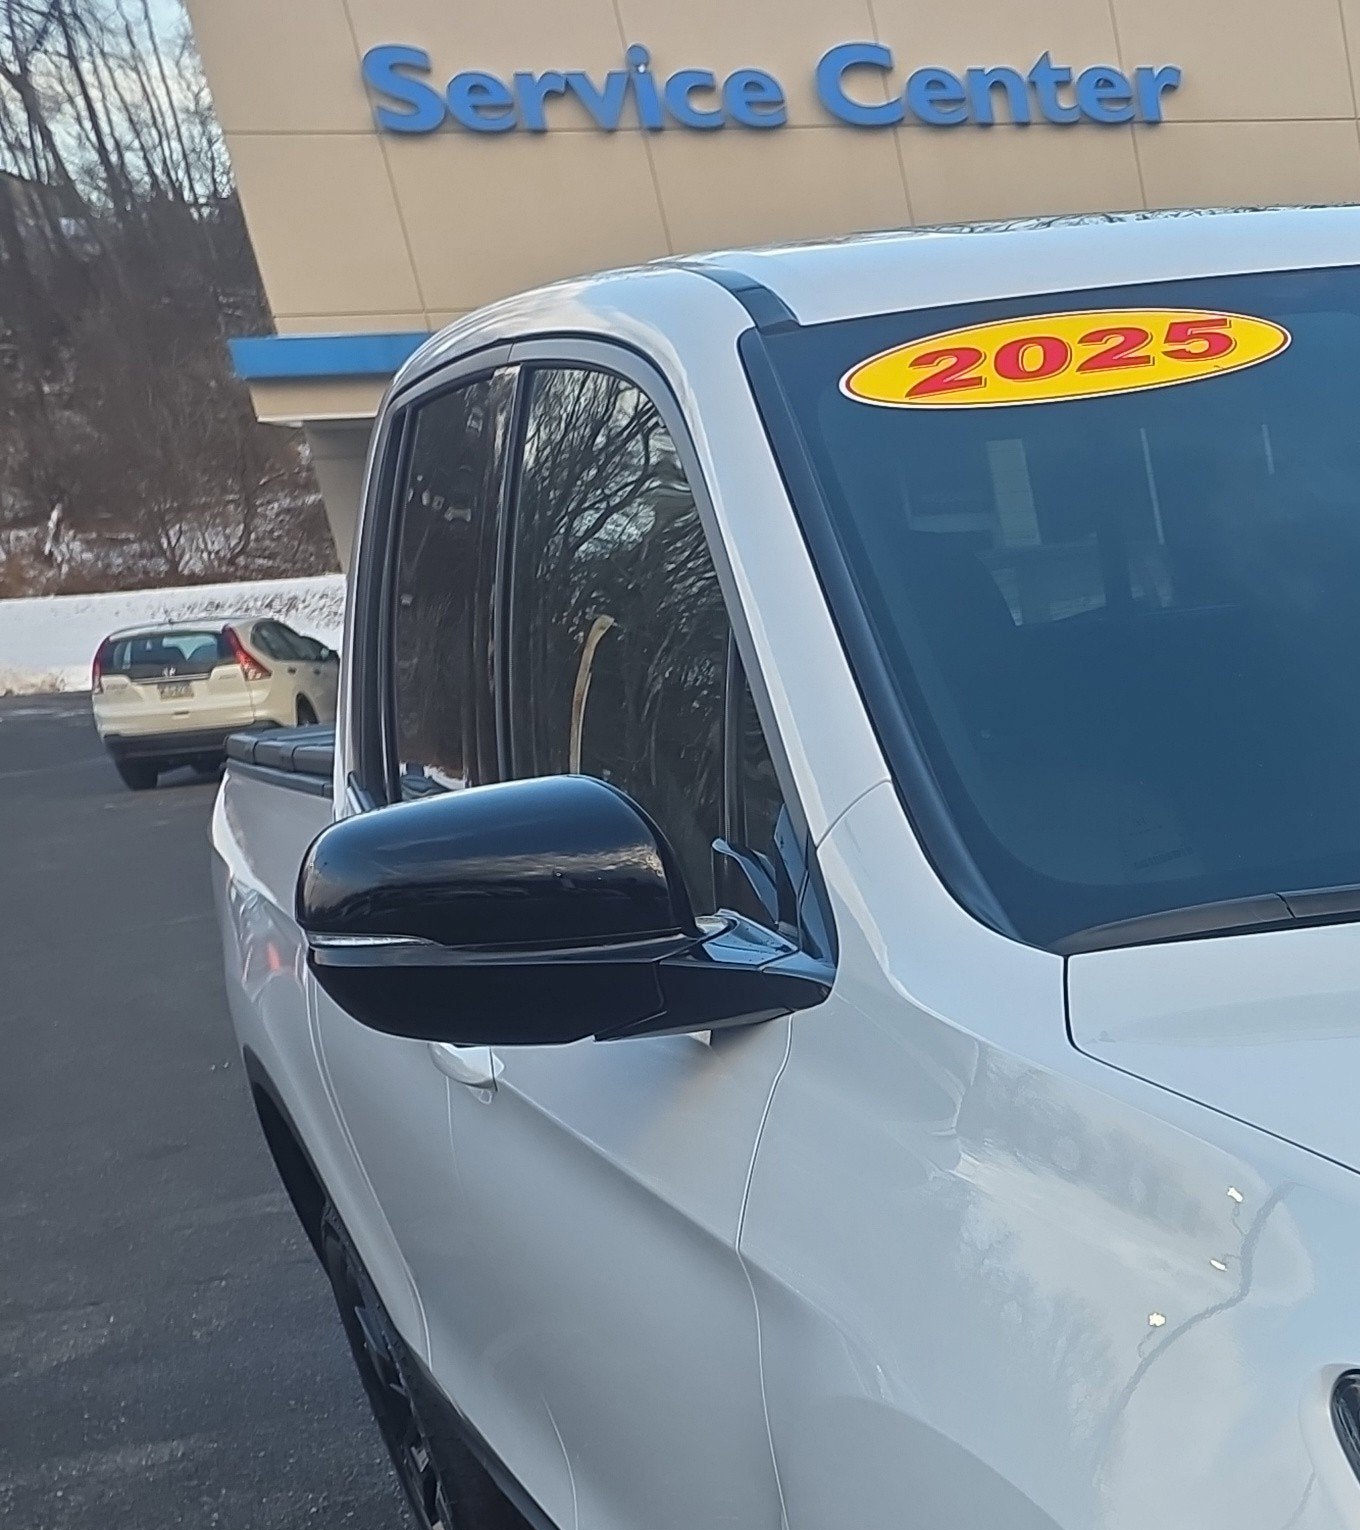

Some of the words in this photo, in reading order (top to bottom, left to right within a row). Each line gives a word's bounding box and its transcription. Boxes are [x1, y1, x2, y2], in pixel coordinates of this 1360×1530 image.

[361, 42, 789, 134] Service
[815, 41, 1182, 126] Center
[904, 317, 1237, 400] 2025
